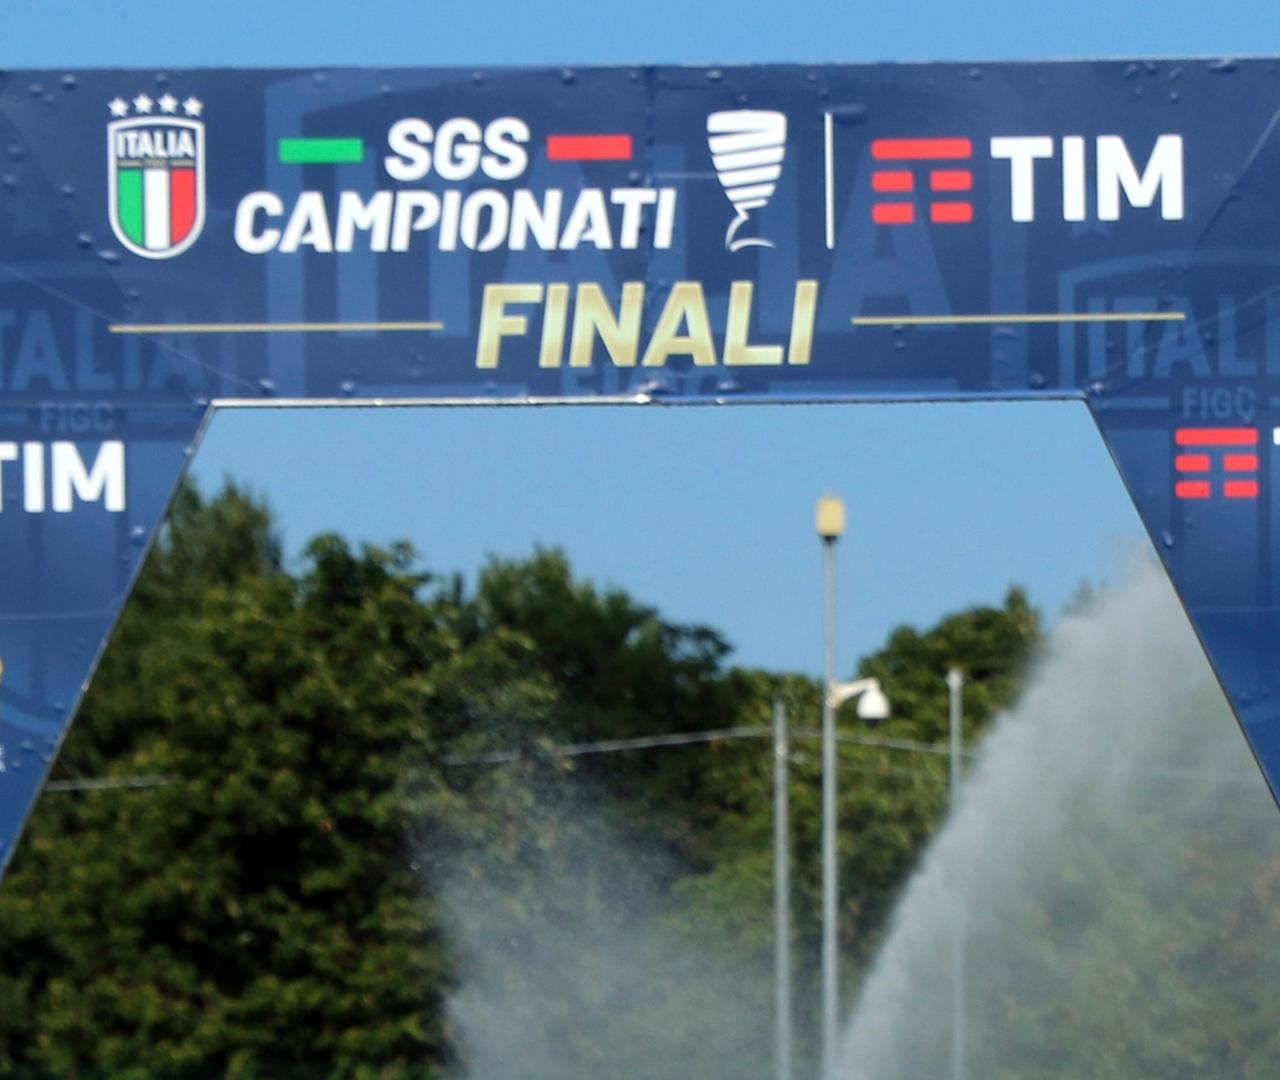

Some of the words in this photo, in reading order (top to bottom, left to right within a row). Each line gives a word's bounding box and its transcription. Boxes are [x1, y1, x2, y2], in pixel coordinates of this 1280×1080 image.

[115, 130, 196, 159] ITALIA
[384, 117, 530, 181] SGS
[990, 135, 1184, 222] TIM
[233, 187, 677, 254] CAMPIONATI
[475, 280, 819, 369] FINALI
